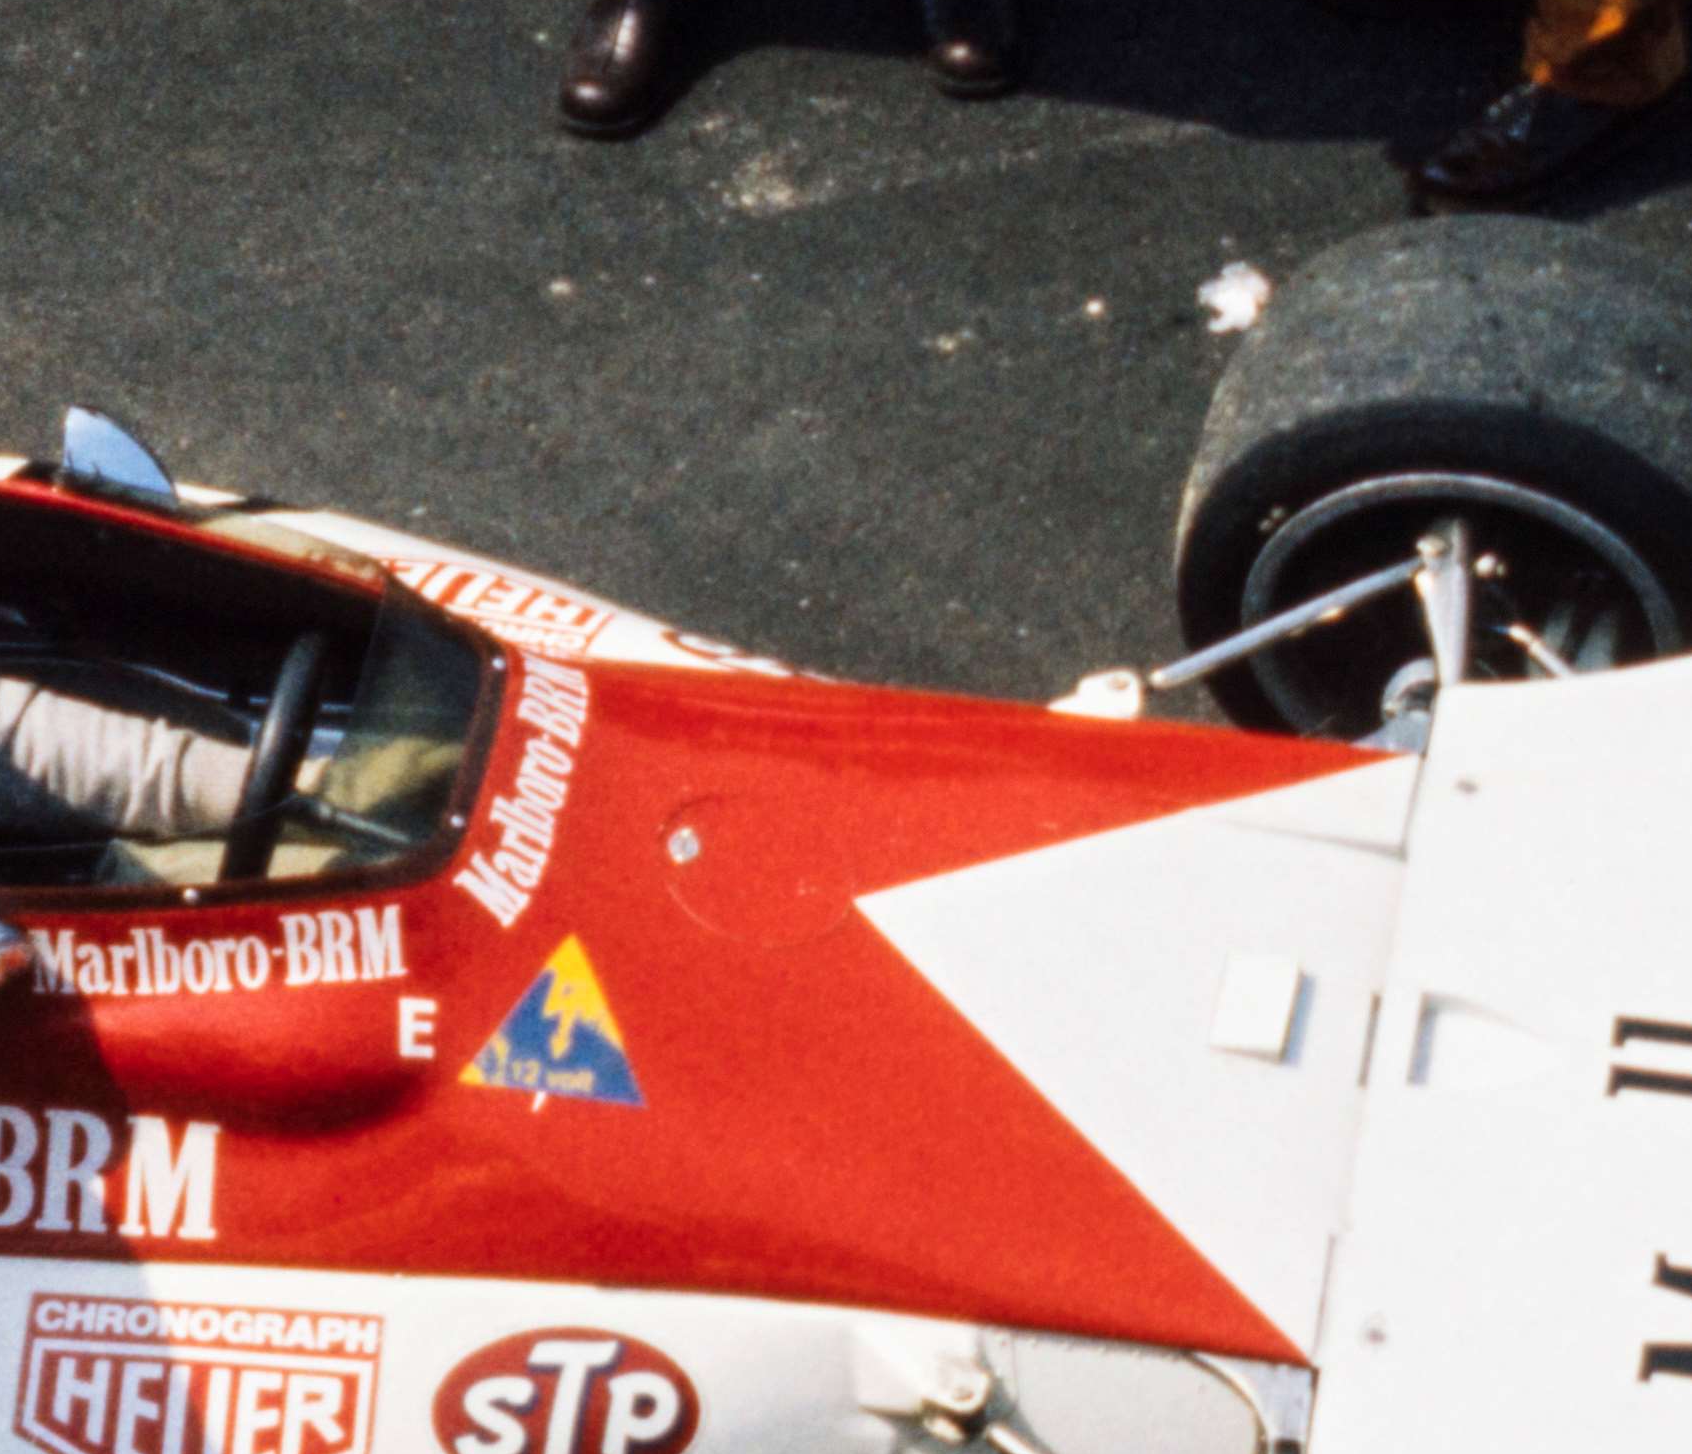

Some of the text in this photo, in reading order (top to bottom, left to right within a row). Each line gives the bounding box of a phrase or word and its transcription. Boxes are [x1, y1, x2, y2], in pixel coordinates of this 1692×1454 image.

[27, 904, 408, 996] Marlboro-BRM
[397, 996, 439, 1060] E
[34, 1298, 380, 1355] CHRONOGRAPH
